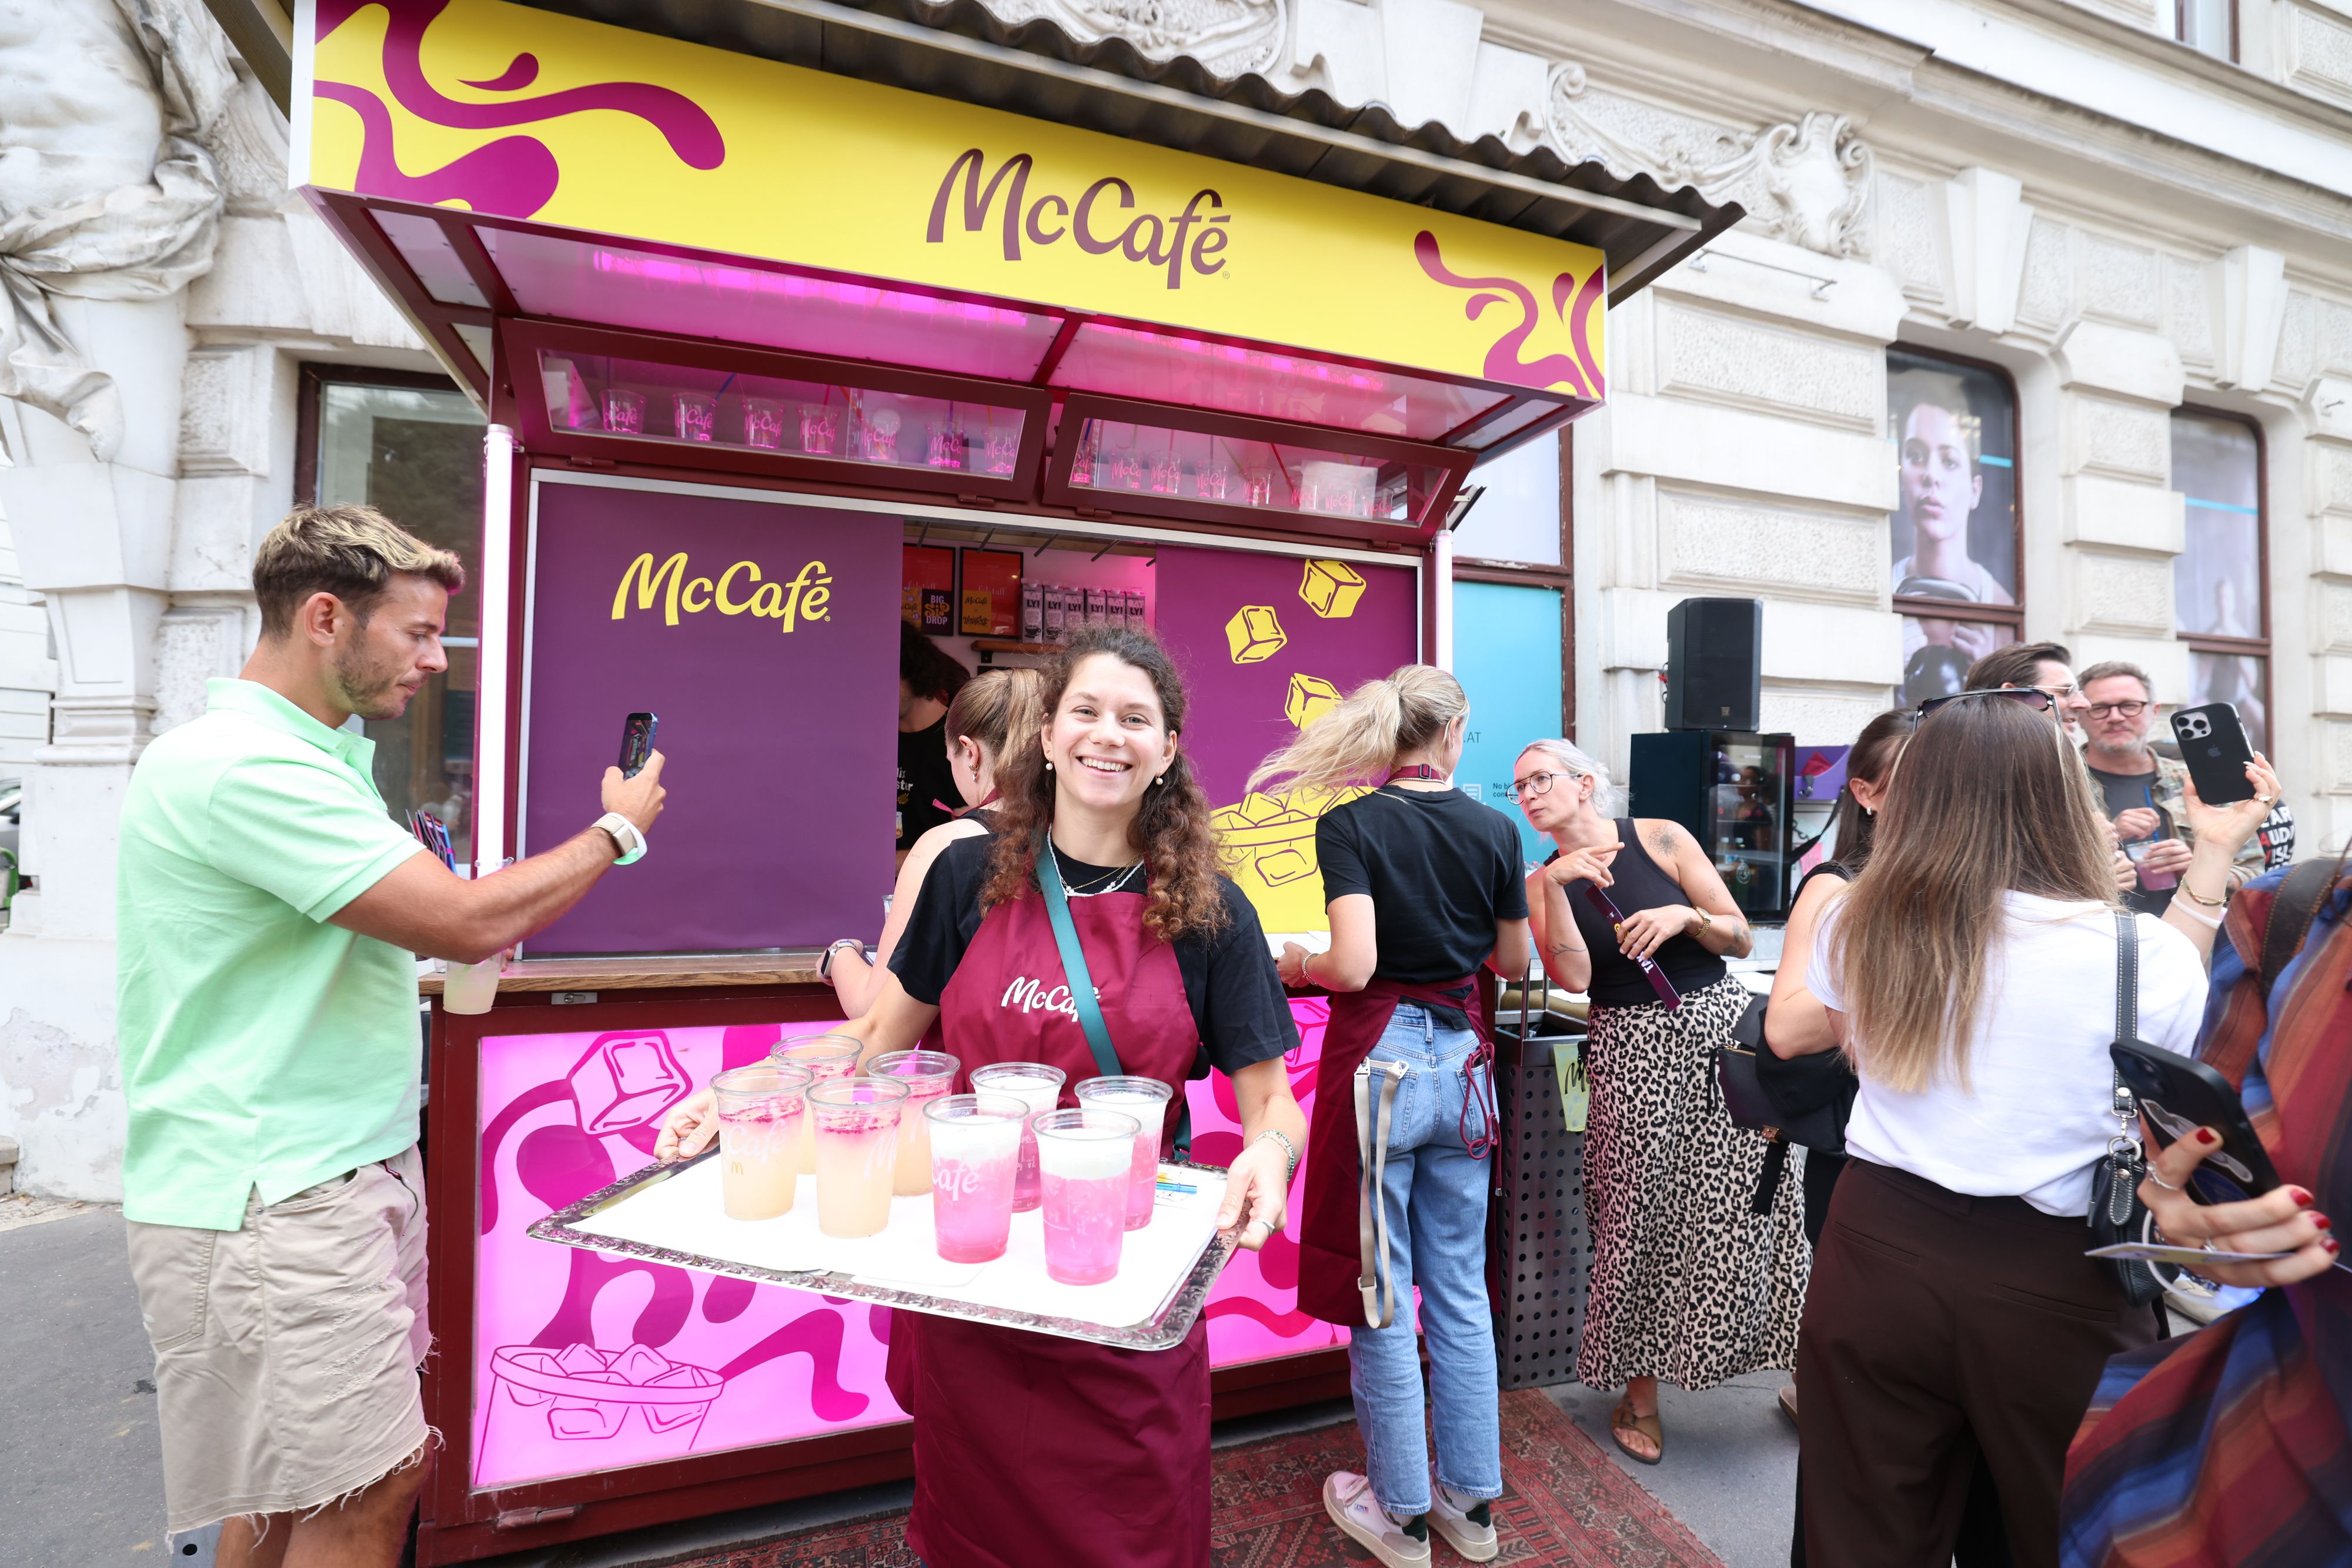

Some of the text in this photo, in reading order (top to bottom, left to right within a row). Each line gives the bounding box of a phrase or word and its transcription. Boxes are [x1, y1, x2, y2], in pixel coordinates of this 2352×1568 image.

[926, 148, 1231, 289] McCafé
[931, 436, 962, 456] McCa
[985, 441, 1015, 460] McCa
[1112, 462, 1142, 482] McCa
[612, 552, 833, 633] McCafé
[931, 595, 944, 603] BIG
[1111, 606, 1123, 614] LY!
[926, 616, 947, 625] DROP
